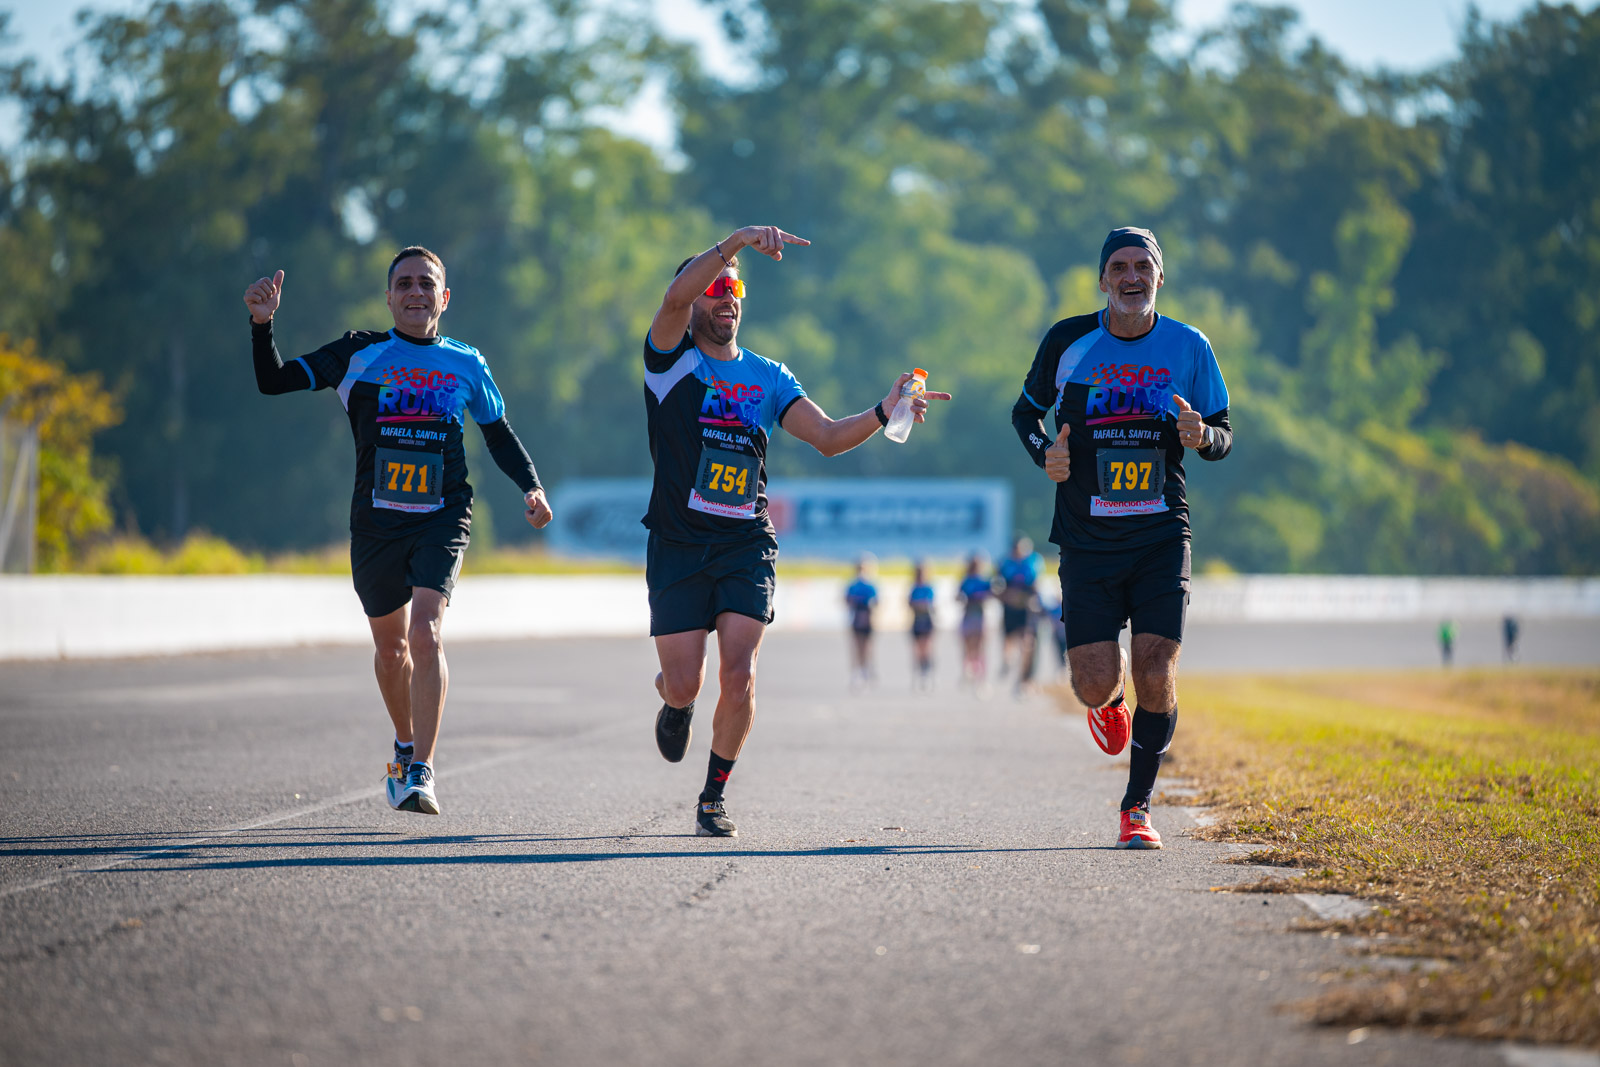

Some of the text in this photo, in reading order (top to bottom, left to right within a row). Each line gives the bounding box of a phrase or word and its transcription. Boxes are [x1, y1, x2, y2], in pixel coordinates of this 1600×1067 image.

[436, 378, 460, 389] MILLAS
[1147, 374, 1173, 384] MILLAS
[378, 386, 456, 416] RUN
[741, 391, 766, 399] MILLAS
[1085, 386, 1169, 416] RUN
[380, 426, 448, 442] RAFAELA, SANTA FE
[702, 427, 734, 444] RAFAELA,
[1093, 428, 1162, 441] RAFAELA, SANTA FE
[387, 461, 428, 494] 771
[708, 462, 748, 496] 754
[1110, 461, 1153, 491] 797
[1153, 460, 1161, 493] EXACTO
